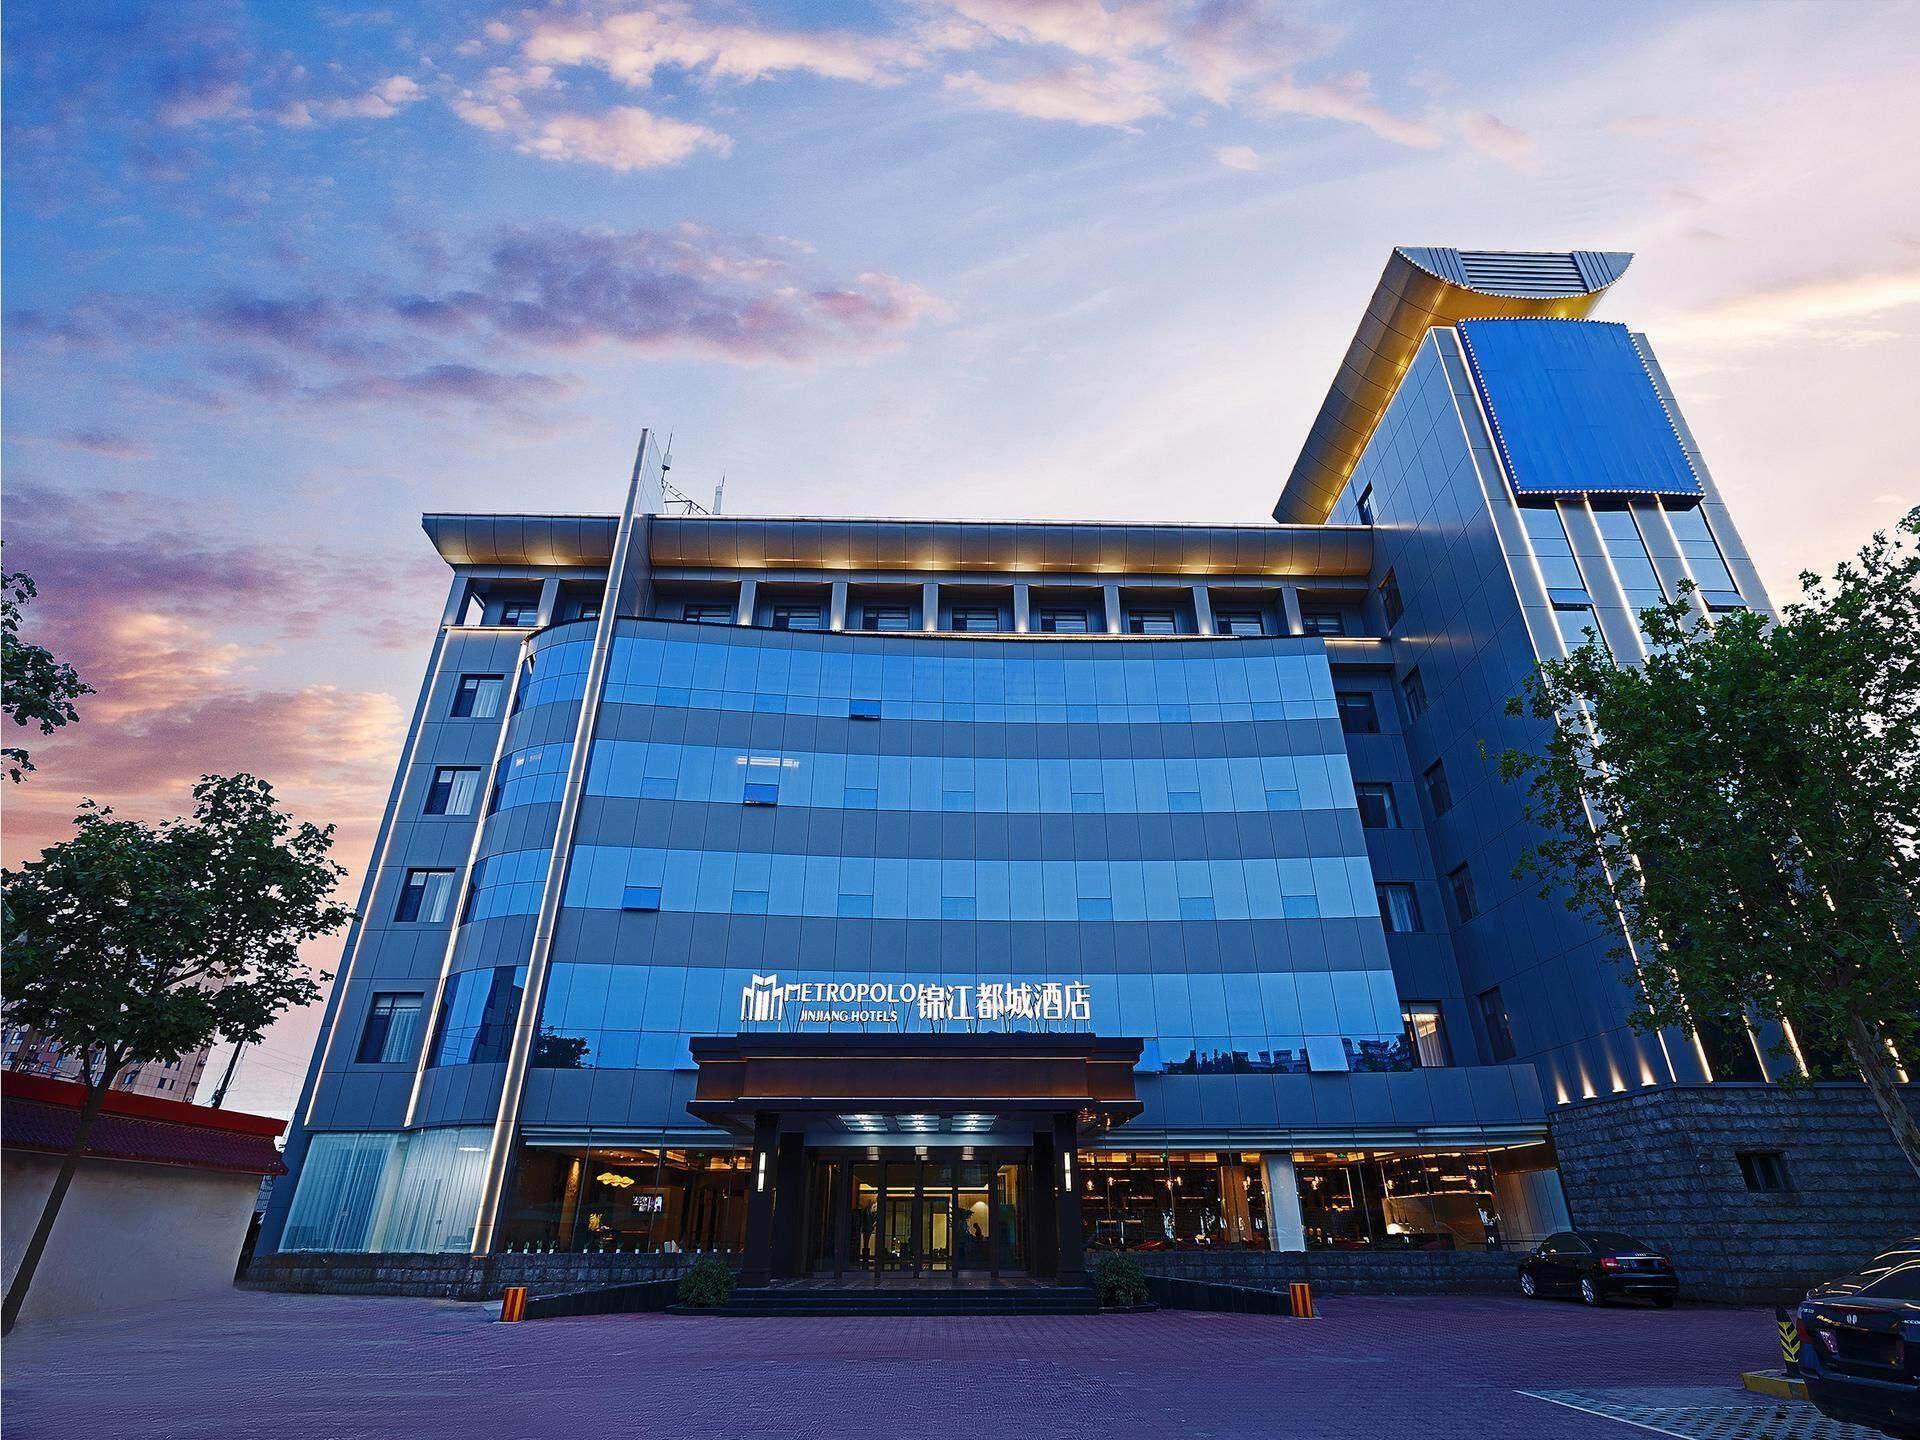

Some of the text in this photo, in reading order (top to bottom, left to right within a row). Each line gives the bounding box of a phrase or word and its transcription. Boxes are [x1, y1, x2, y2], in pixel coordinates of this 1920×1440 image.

[784, 983, 917, 1003] METROPOLO
[917, 981, 1091, 1021] 锦江都城酒店
[800, 1010, 898, 1022] JINJIANG HOTELS
